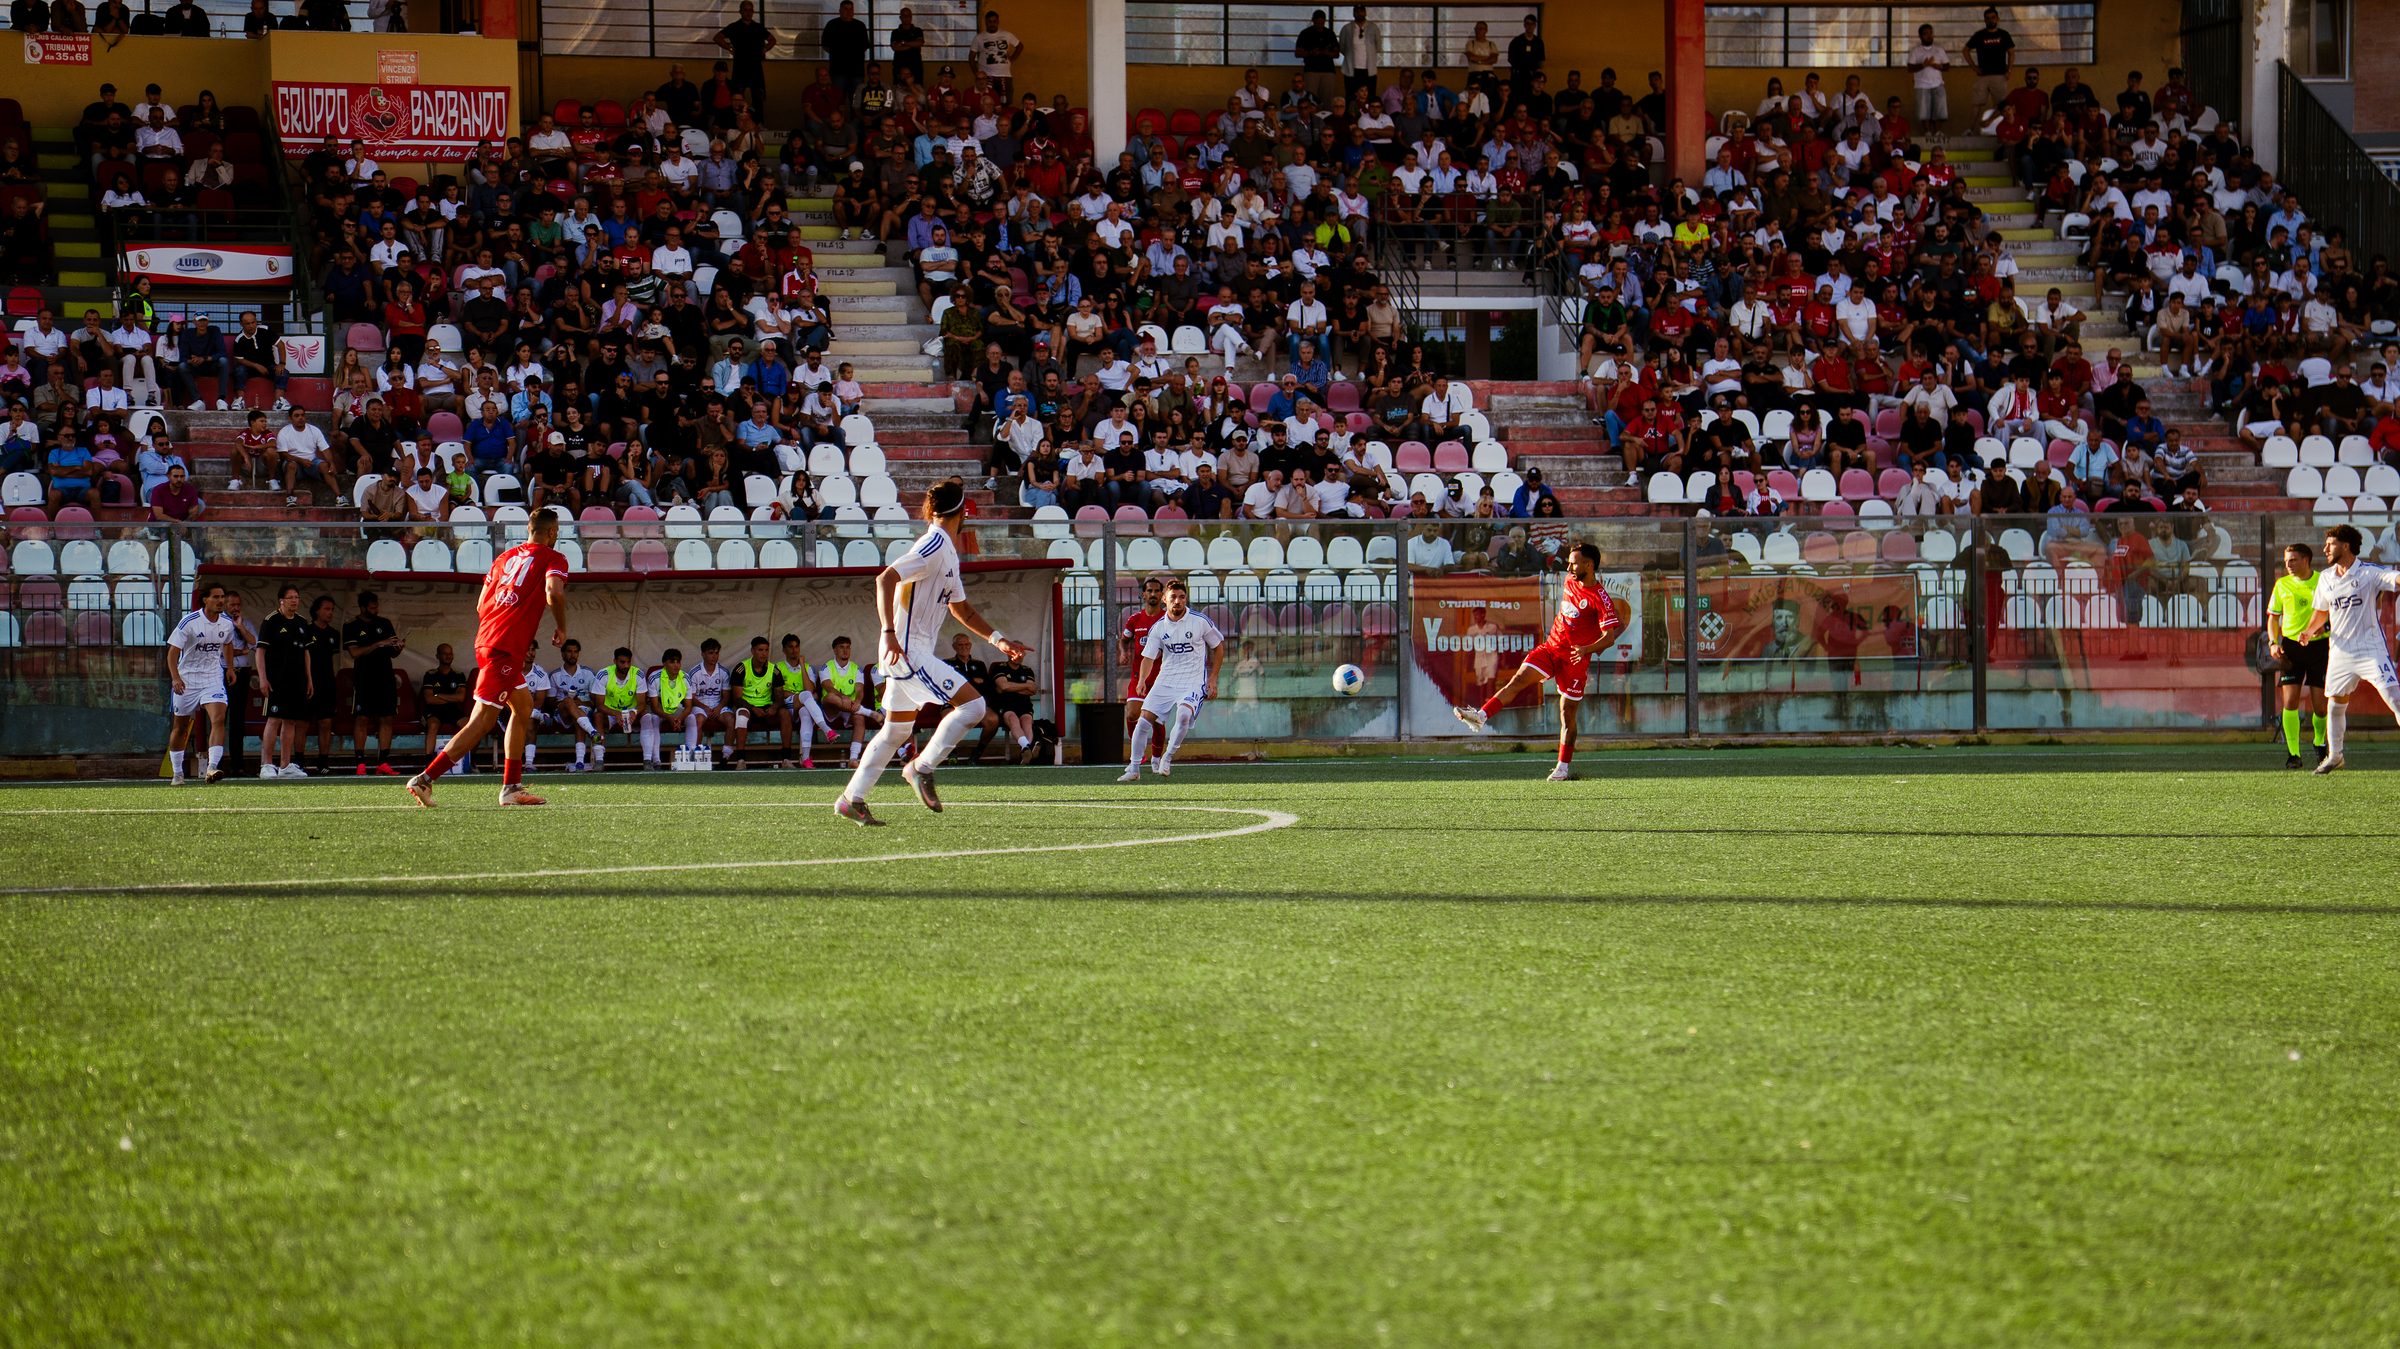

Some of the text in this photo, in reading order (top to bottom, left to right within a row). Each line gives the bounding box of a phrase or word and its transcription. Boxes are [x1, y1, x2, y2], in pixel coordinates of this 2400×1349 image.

[45, 43, 89, 52] TRIBUNA VIP
[55, 53, 69, 61] 35
[75, 53, 90, 61] 68
[381, 65, 416, 73] VINCENZO
[386, 75, 412, 84] STRINO
[278, 87, 506, 138] GRUPPO BARBANDO
[423, 146, 441, 158] al
[442, 147, 463, 158] tuo
[179, 258, 220, 268] LUBLAN
[500, 555, 534, 586] 91
[1673, 597, 1709, 609] TUIS
[1573, 679, 1579, 688] 7
